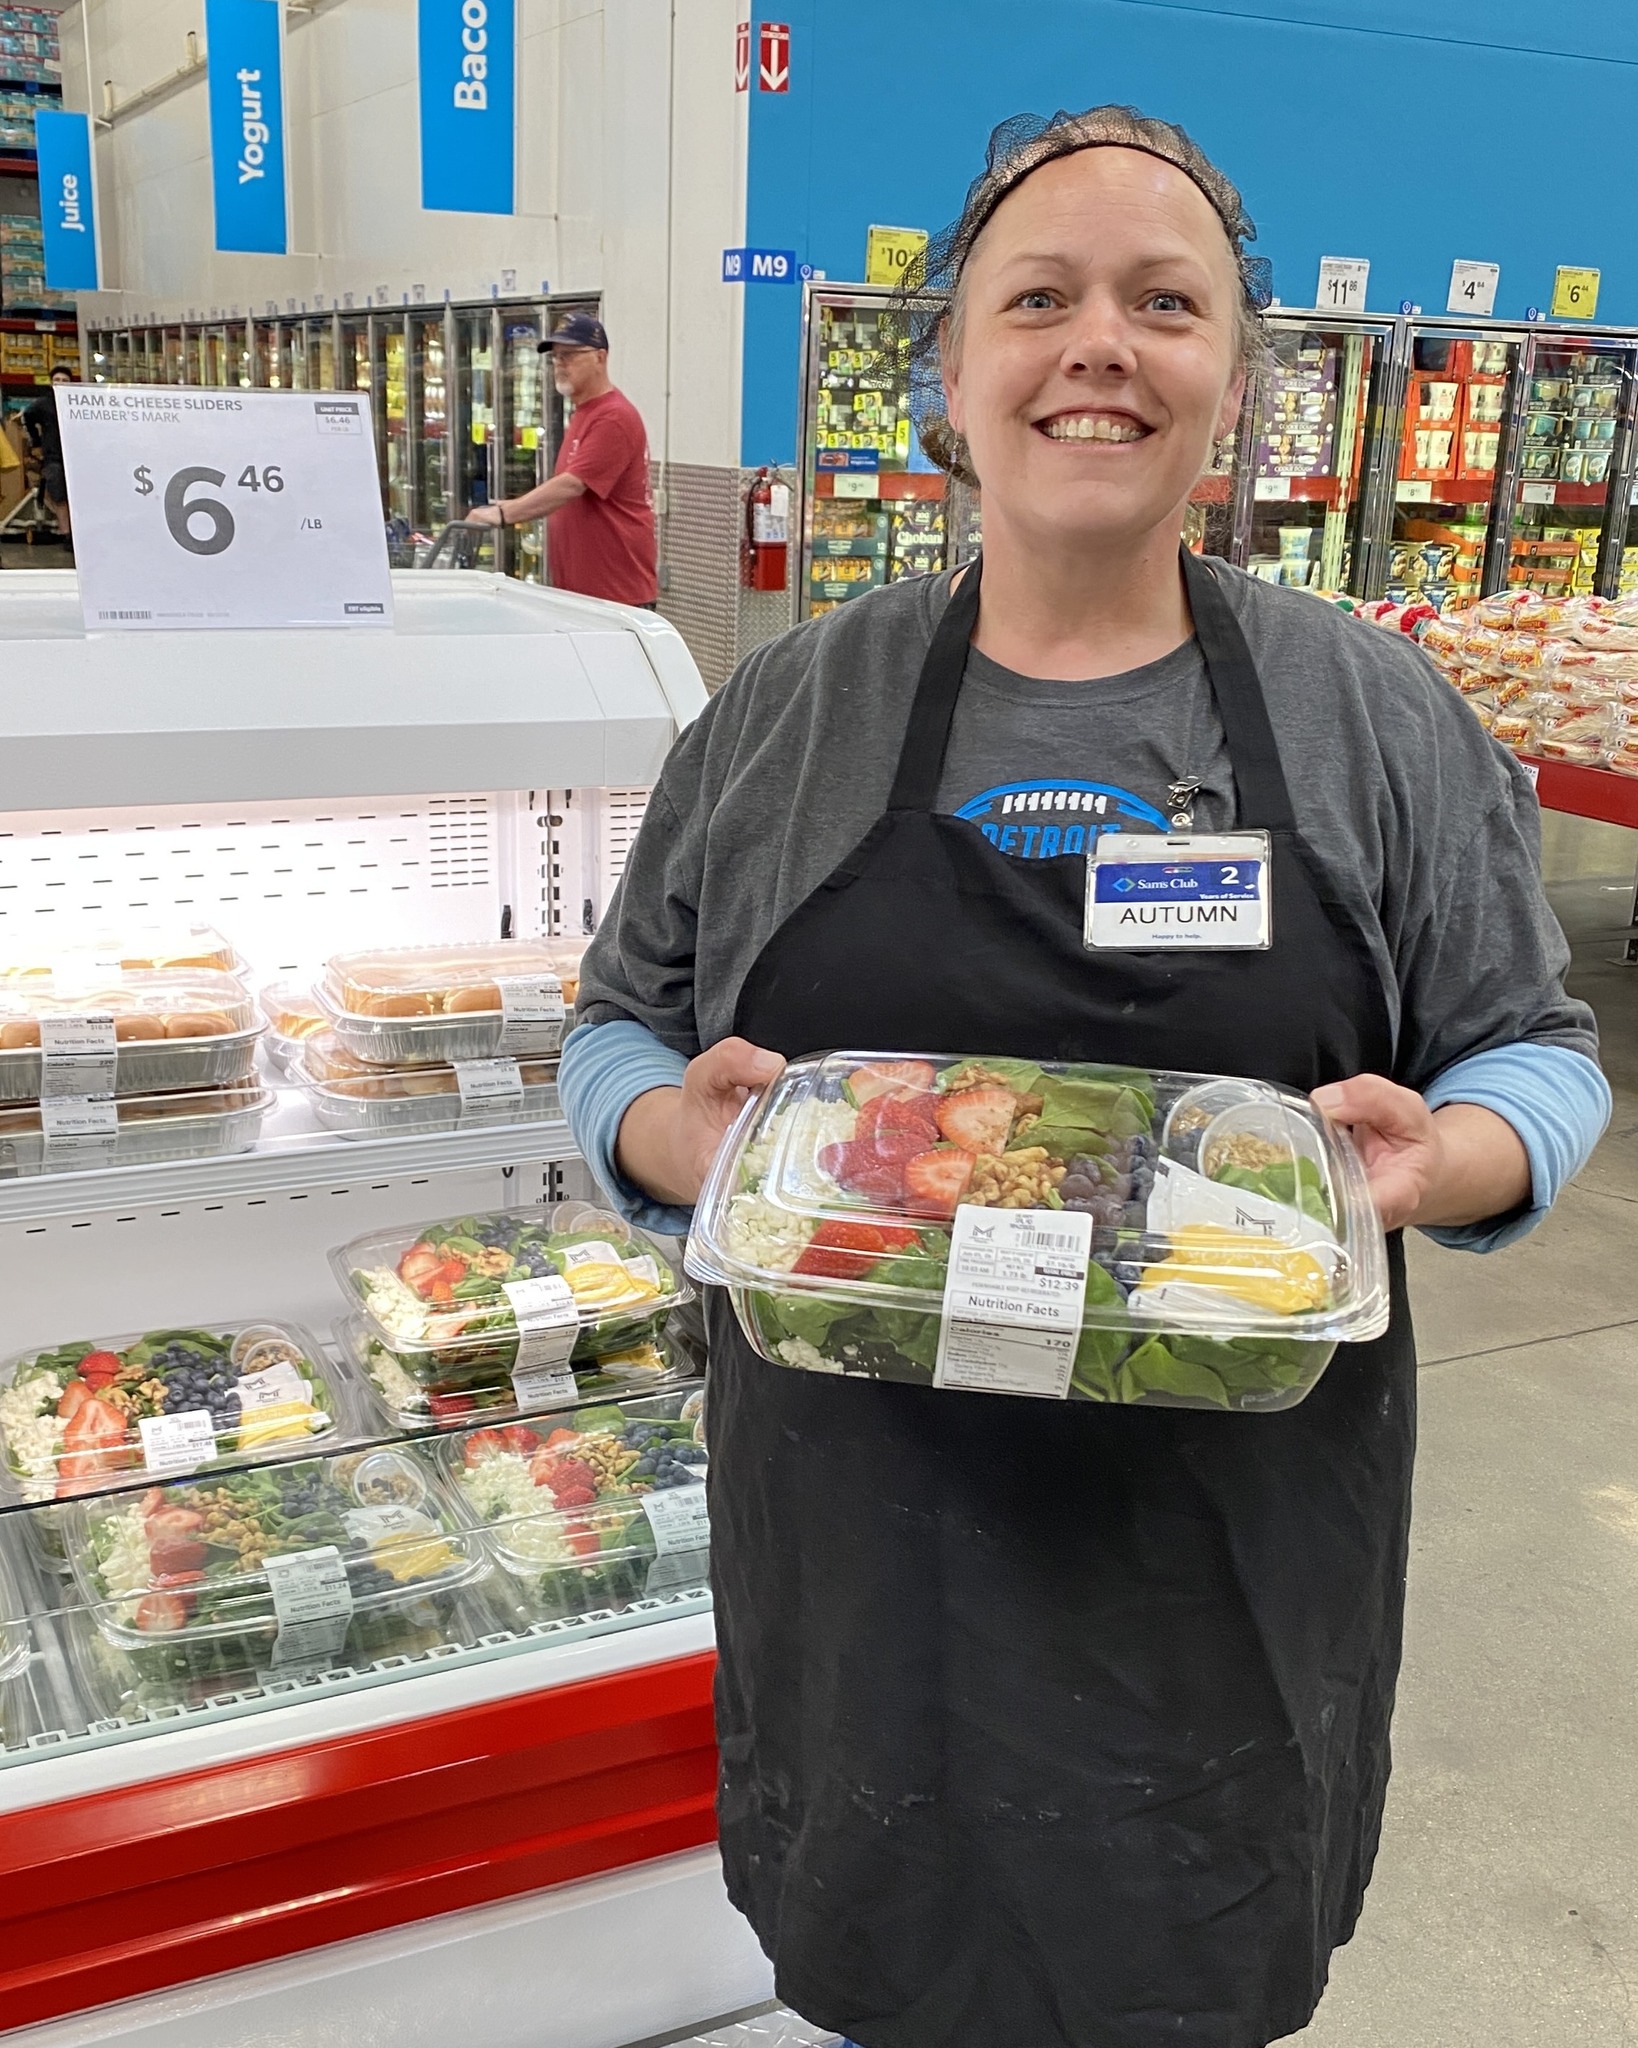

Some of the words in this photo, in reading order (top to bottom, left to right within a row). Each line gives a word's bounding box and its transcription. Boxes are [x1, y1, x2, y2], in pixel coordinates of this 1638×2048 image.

[237, 68, 269, 184] Yogurt
[60, 174, 86, 232] Juice
[752, 254, 788, 277] M9
[67, 394, 104, 407] HAM
[109, 396, 121, 408] &
[124, 396, 181, 410] CHEESE
[184, 397, 243, 411] SLIDERS
[69, 409, 139, 422] MEMBER'S
[142, 411, 181, 423] MARK
[325, 416, 351, 424] $6.46
[899, 428, 906, 439] 5
[301, 517, 323, 530] /LB
[897, 531, 944, 546] Chobani
[1220, 866, 1240, 885] 2
[1170, 878, 1199, 889] Club
[1119, 905, 1238, 925] AUTUMN
[1152, 933, 1174, 941] Happy
[54, 1038, 85, 1046] Nutrition
[470, 1081, 496, 1090] Nutrition
[56, 1119, 87, 1127] Nutrition
[1039, 1277, 1079, 1291] $12.39
[968, 1296, 1023, 1312] Nutrition
[1026, 1303, 1060, 1317] Facts
[950, 1326, 1000, 1337] Calories
[1045, 1338, 1071, 1348] 170
[527, 1390, 552, 1398] Nutrition
[159, 1457, 188, 1467] Nutrition
[668, 1536, 694, 1546] Nutrition
[290, 1601, 321, 1613] Nutrition
[322, 1599, 341, 1608] Facts
